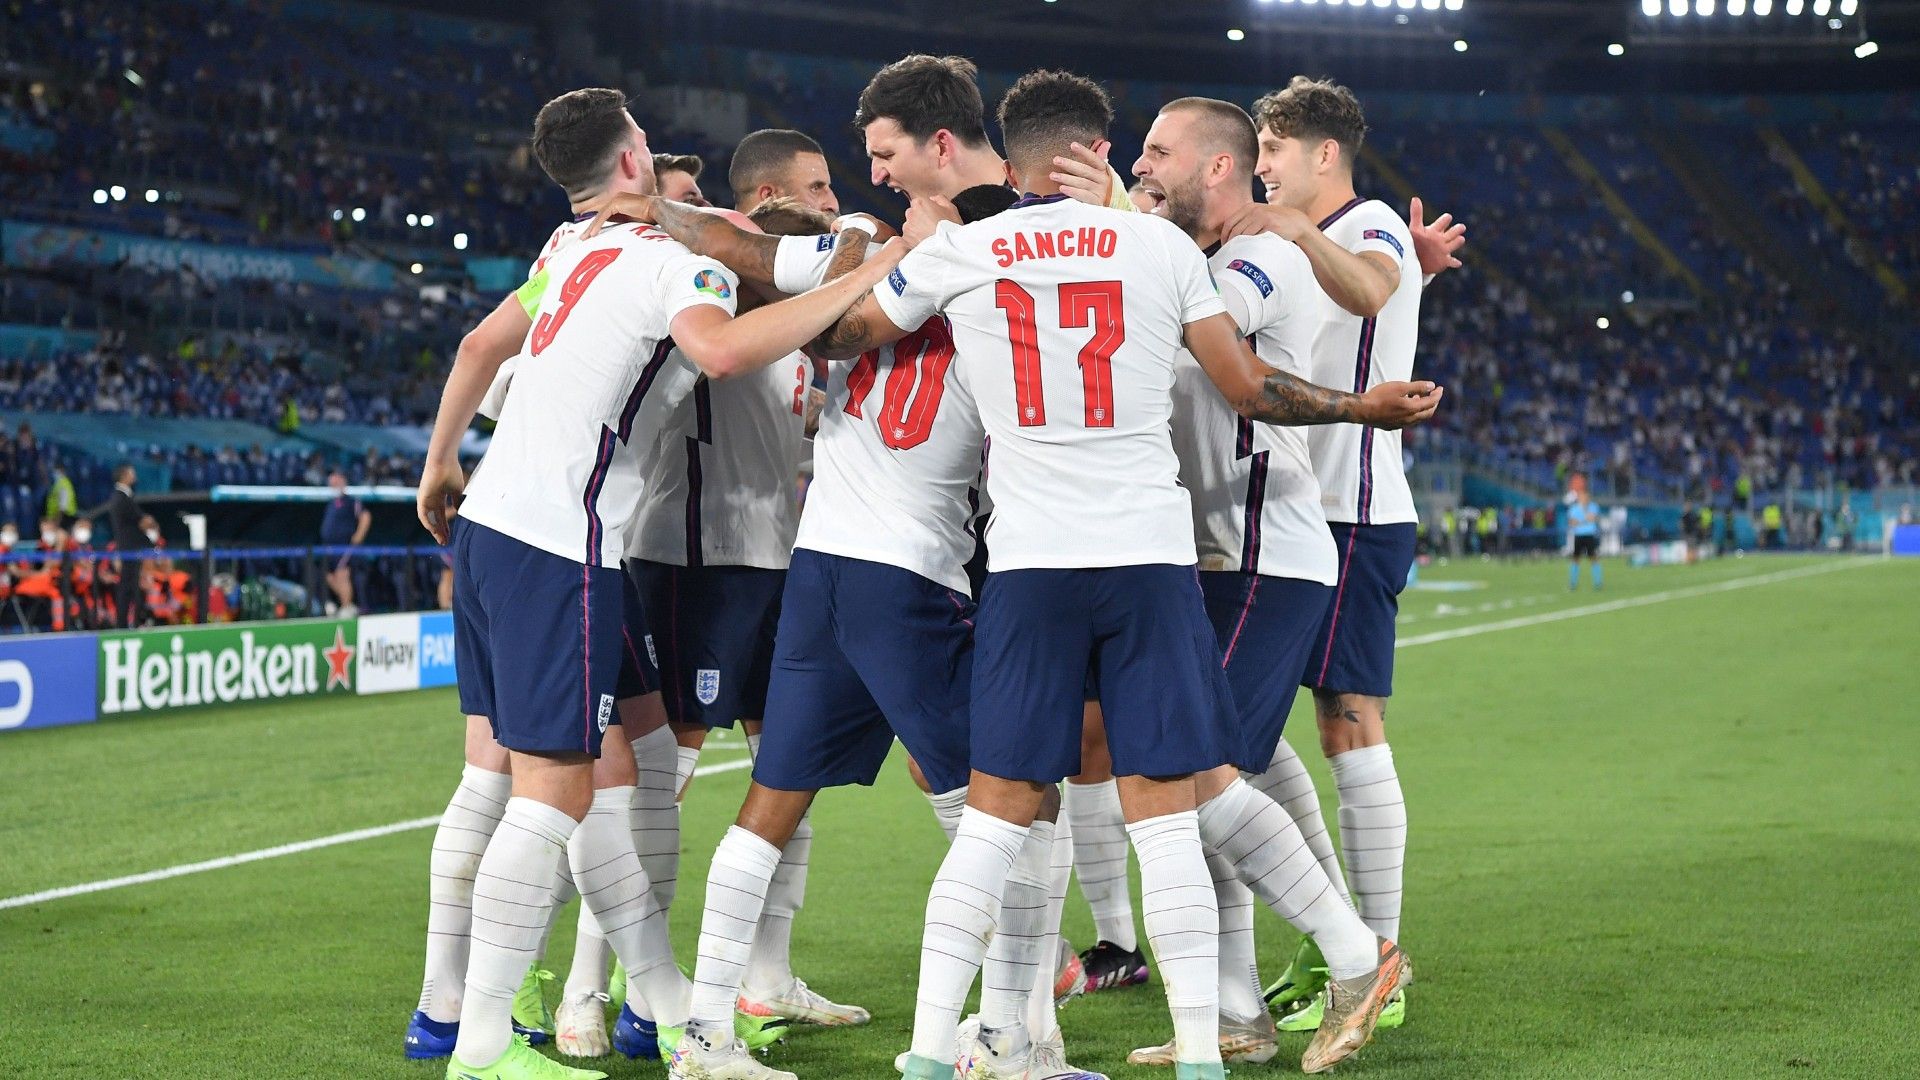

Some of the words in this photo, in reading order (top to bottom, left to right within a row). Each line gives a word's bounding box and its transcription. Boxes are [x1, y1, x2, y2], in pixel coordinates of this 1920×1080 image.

[991, 227, 1118, 268] SANCHO
[1241, 264, 1272, 296] RESPECT
[531, 247, 624, 357] 9
[843, 314, 956, 451] 10
[994, 277, 1125, 428] 17
[792, 364, 805, 417] 2
[101, 631, 319, 714] Heineken
[363, 636, 416, 671] Alipay
